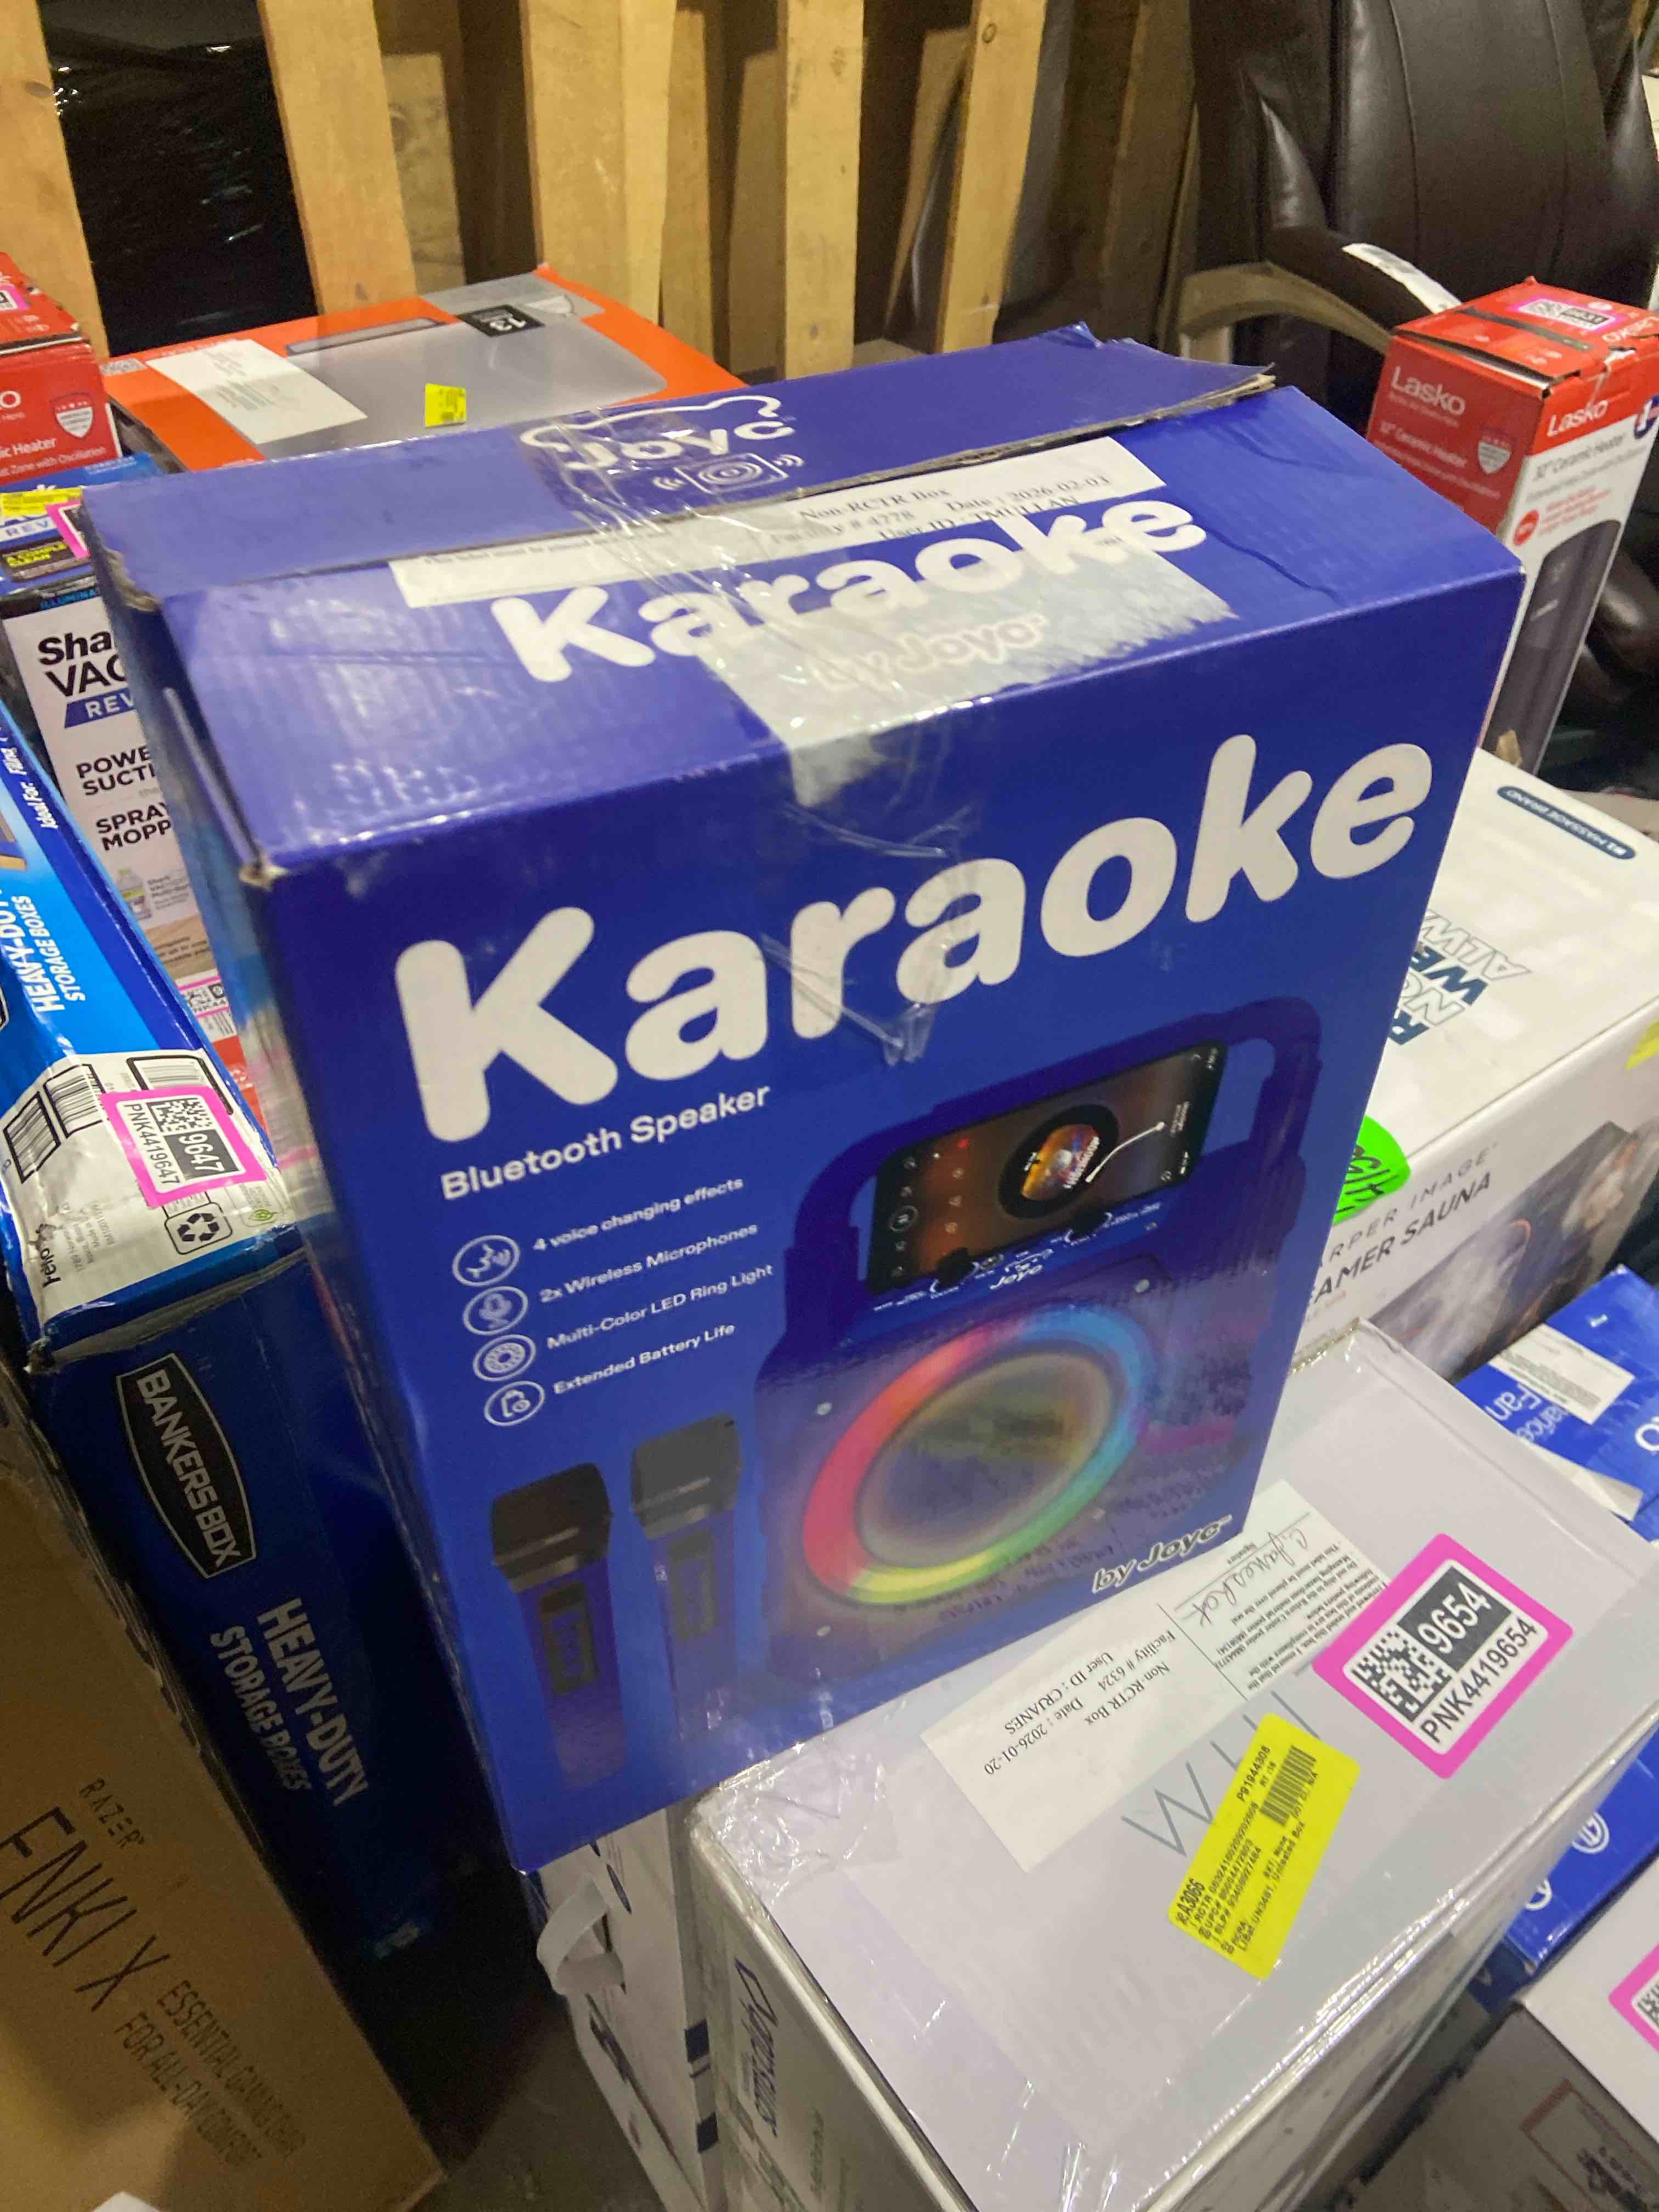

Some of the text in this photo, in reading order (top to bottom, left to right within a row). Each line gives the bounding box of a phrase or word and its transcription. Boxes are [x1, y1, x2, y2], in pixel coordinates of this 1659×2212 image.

[1391, 367, 1465, 415] Lasko
[1547, 400, 1609, 437] Lasko
[14, 438, 56, 454] Heater
[491, 500, 1208, 682] Karaoke
[38, 631, 113, 665] Sha
[12, 894, 86, 1002] STORAGE BOXES
[394, 734, 1433, 1143] Karaoke
[122, 1103, 180, 1186] PNK4419647
[180, 1133, 225, 1173] 9647
[441, 1085, 770, 1201] Bluetooth Speaker
[533, 1176, 744, 1251] 4 voice changing effects
[1401, 1171, 1492, 1246] SAUNA
[539, 1223, 759, 1304] 2x Wireless Microphones
[547, 1264, 774, 1350] Multi-Color LED Ring Light
[553, 1323, 737, 1396] Extended Battery Life
[136, 1368, 240, 1568] BANKERS BOX
[1092, 1558, 1137, 1594] by
[1417, 1582, 1492, 1654] 9654
[211, 1625, 281, 1739] STORAGE
[1068, 1669, 1087, 1688] ID
[1085, 1650, 1114, 1675] User
[1096, 1665, 1126, 1691] 6324
[1420, 1616, 1537, 1745] PNK4419654
[257, 1597, 370, 1809] HEAVY-DUTY
[1052, 1696, 1084, 1724] Date
[1082, 1704, 1110, 1729] Box
[984, 1723, 1049, 1775] 2026-01-20
[78, 1778, 145, 1849] RAZER
[75, 1934, 171, 2012] X
[114, 2010, 165, 2053] FOR
[156, 1980, 237, 2079] ESSENTIAL
